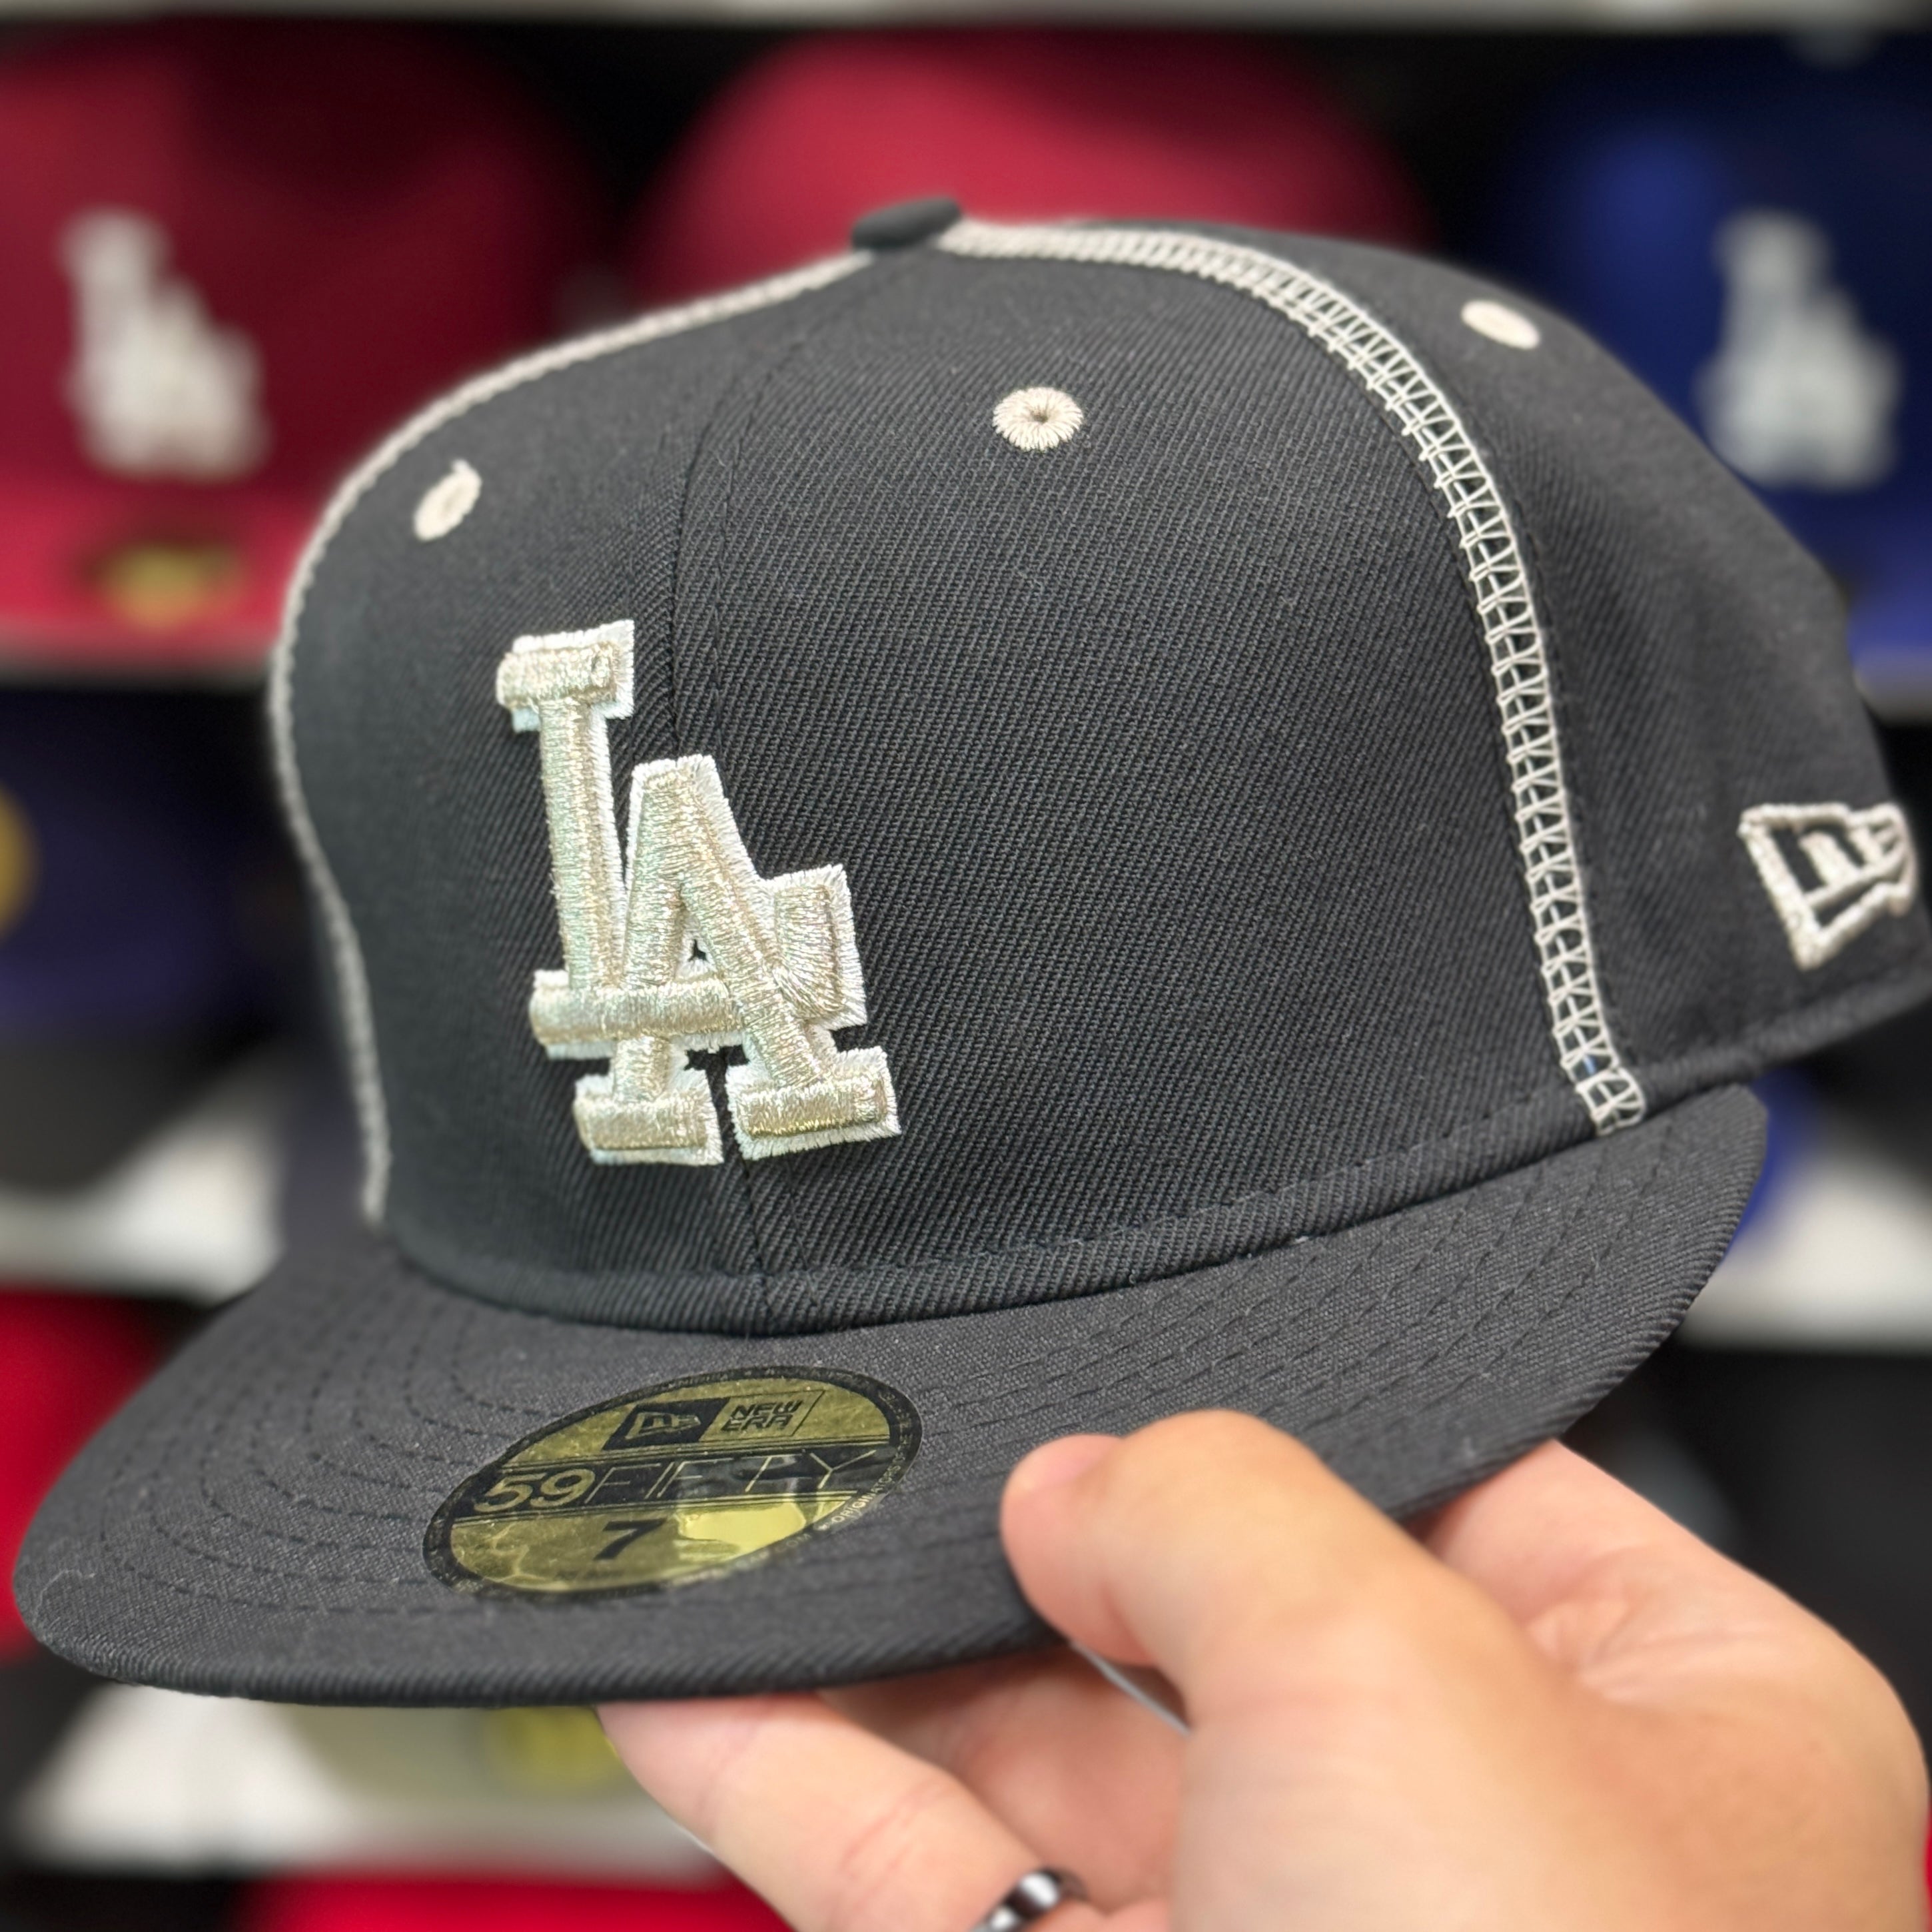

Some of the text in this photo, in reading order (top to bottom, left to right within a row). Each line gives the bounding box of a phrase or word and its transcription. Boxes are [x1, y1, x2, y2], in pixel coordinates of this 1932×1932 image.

[496, 619, 901, 1165] LA
[720, 1414, 793, 1432] ERA
[730, 1400, 803, 1418] NEW
[594, 1518, 668, 1561] 7
